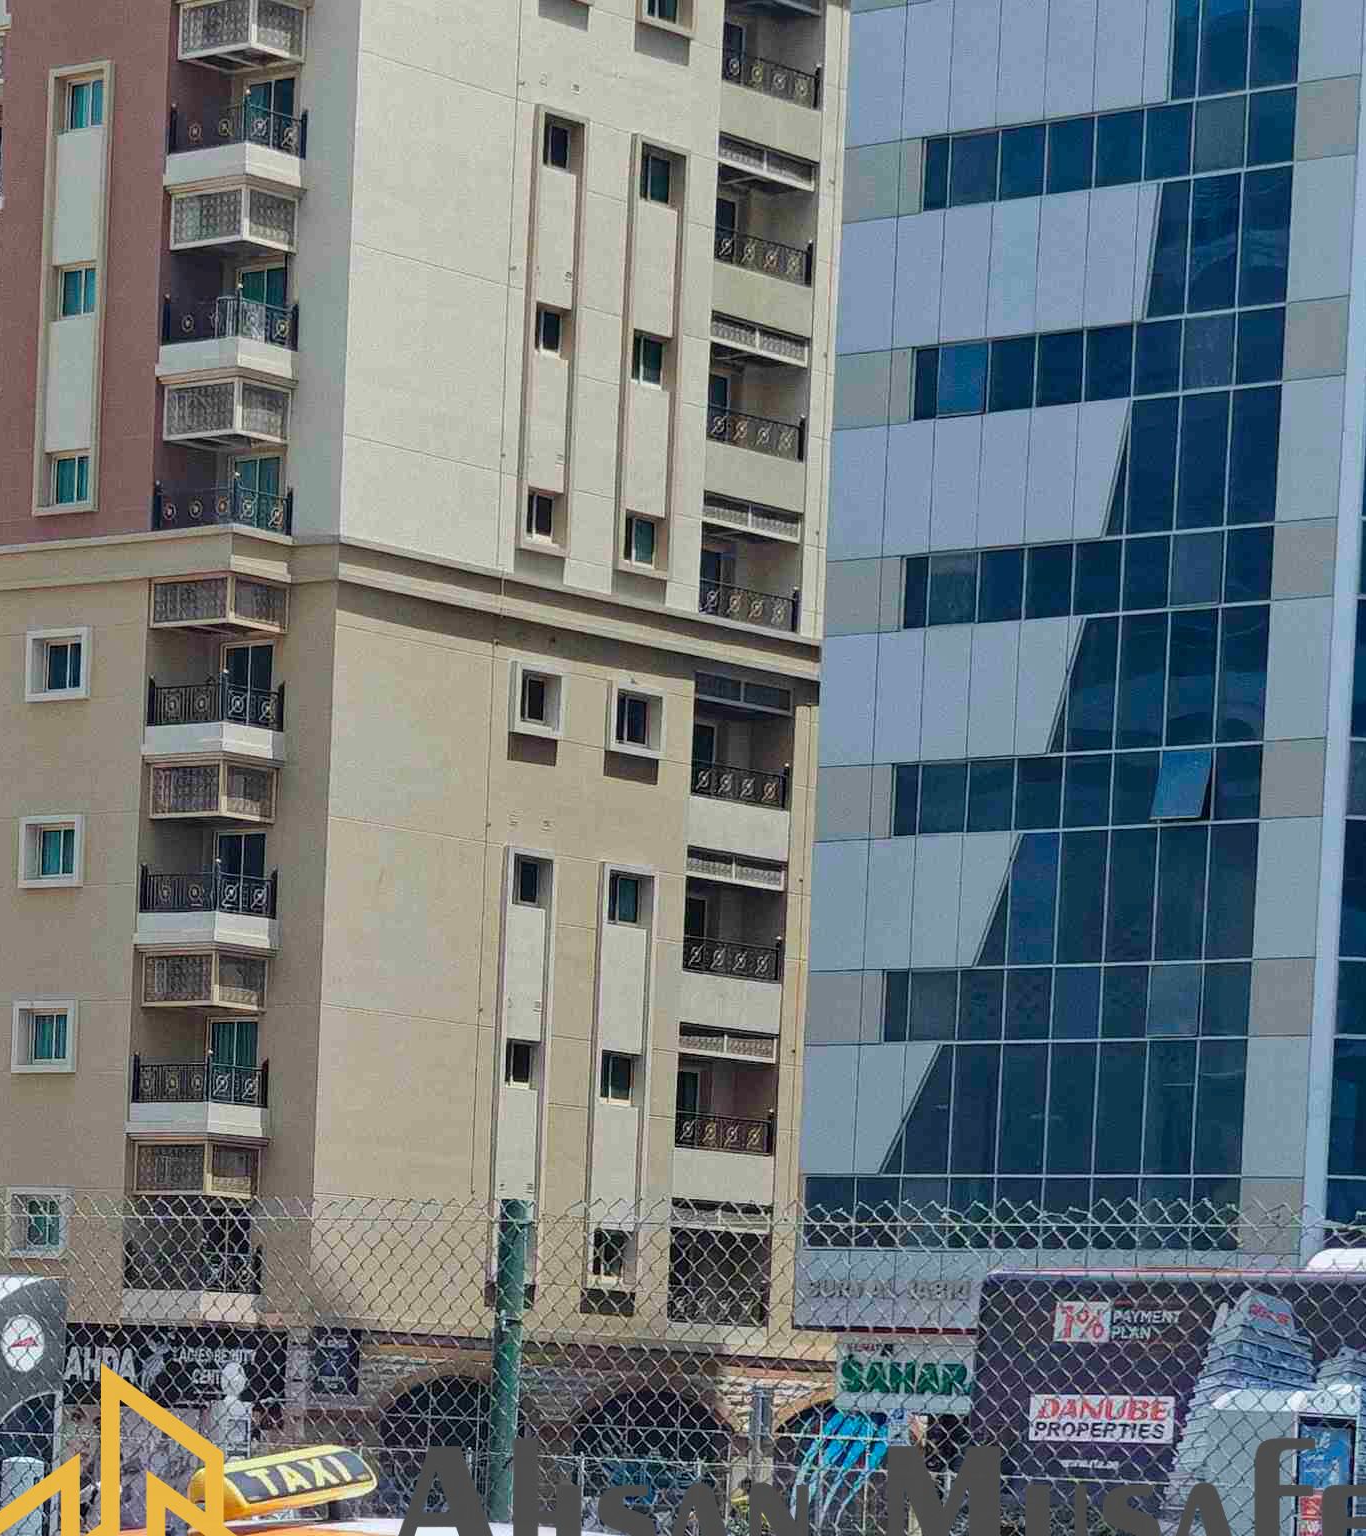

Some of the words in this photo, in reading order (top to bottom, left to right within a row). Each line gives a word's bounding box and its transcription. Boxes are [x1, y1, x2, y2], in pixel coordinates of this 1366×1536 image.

[1112, 1309, 1182, 1325] PAYMENT
[1111, 1326, 1152, 1340] PLAN
[1036, 1398, 1170, 1422] DANUBE
[1034, 1421, 1166, 1440] PROPERTIES
[245, 1454, 354, 1498] TAXI
